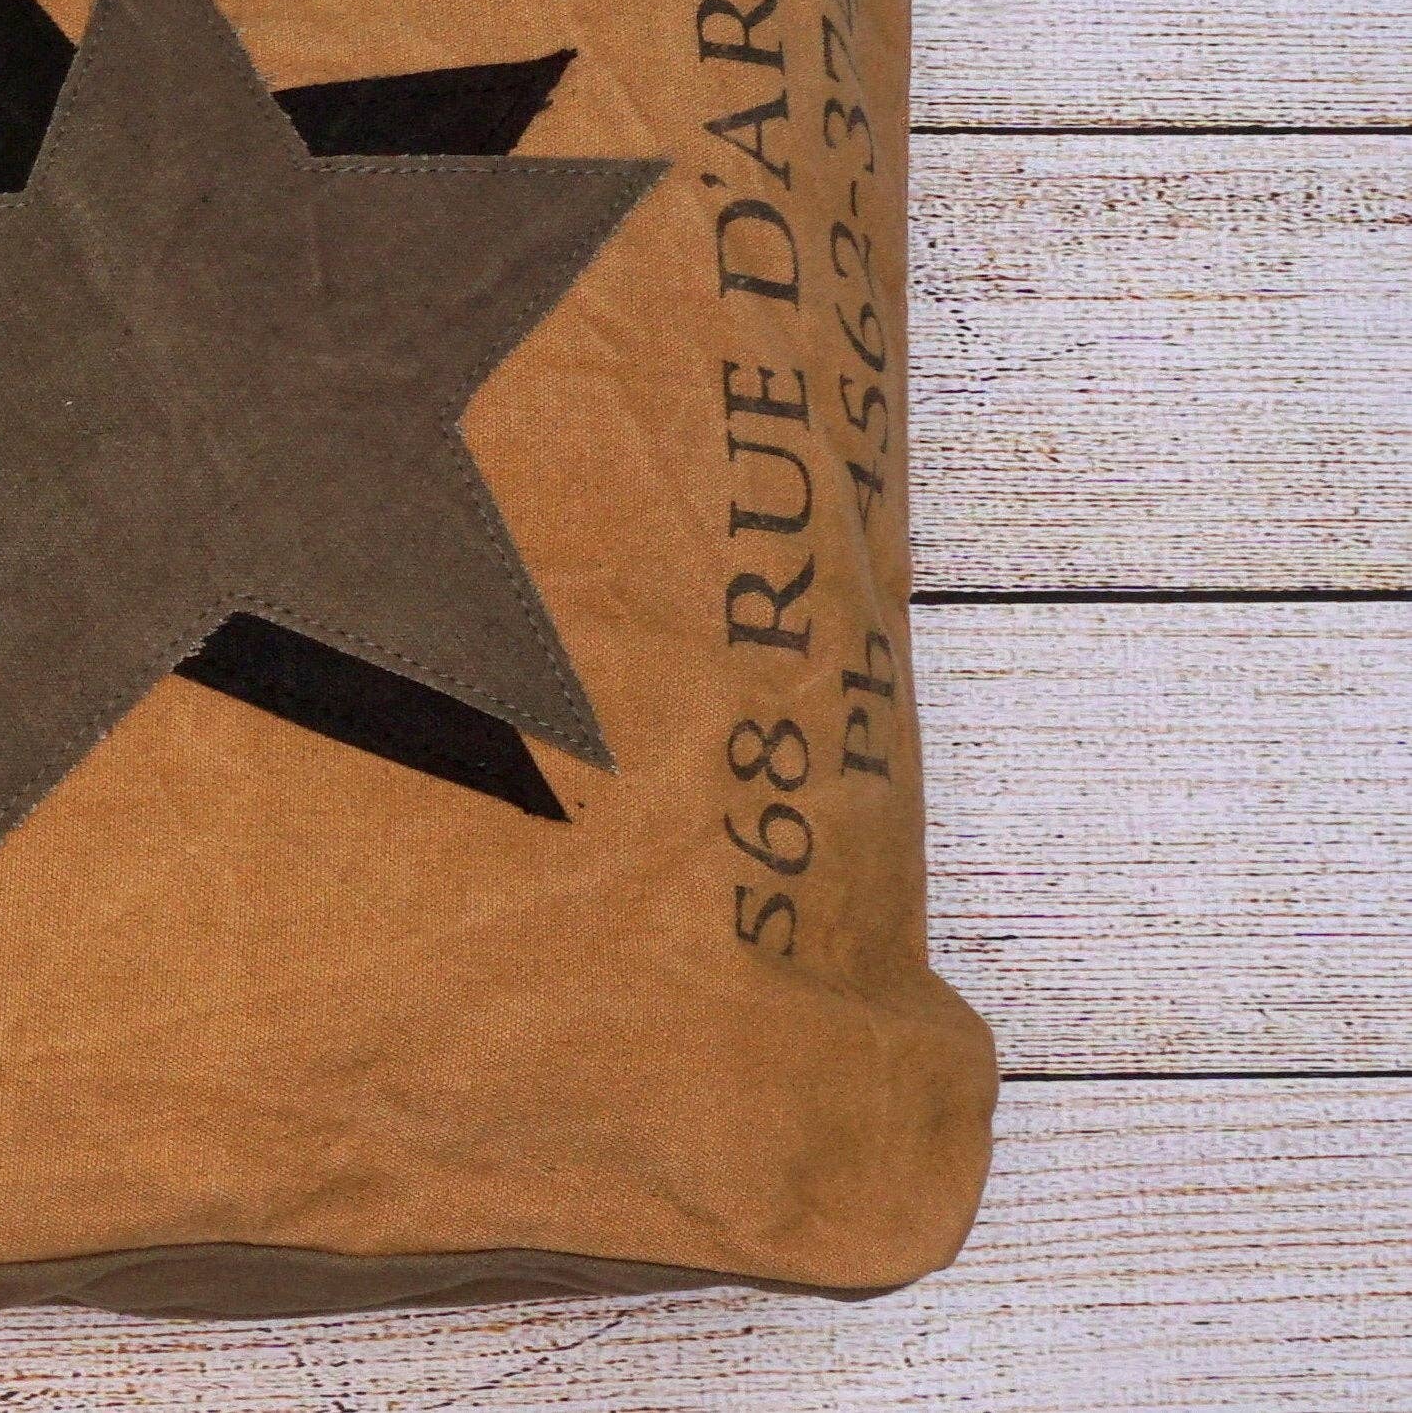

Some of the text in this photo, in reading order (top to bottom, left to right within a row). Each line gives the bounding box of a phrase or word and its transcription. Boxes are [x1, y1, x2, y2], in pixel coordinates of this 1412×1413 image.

[721, 360, 816, 657] RUE
[839, 628, 898, 785] Ph
[723, 718, 814, 957] 568
